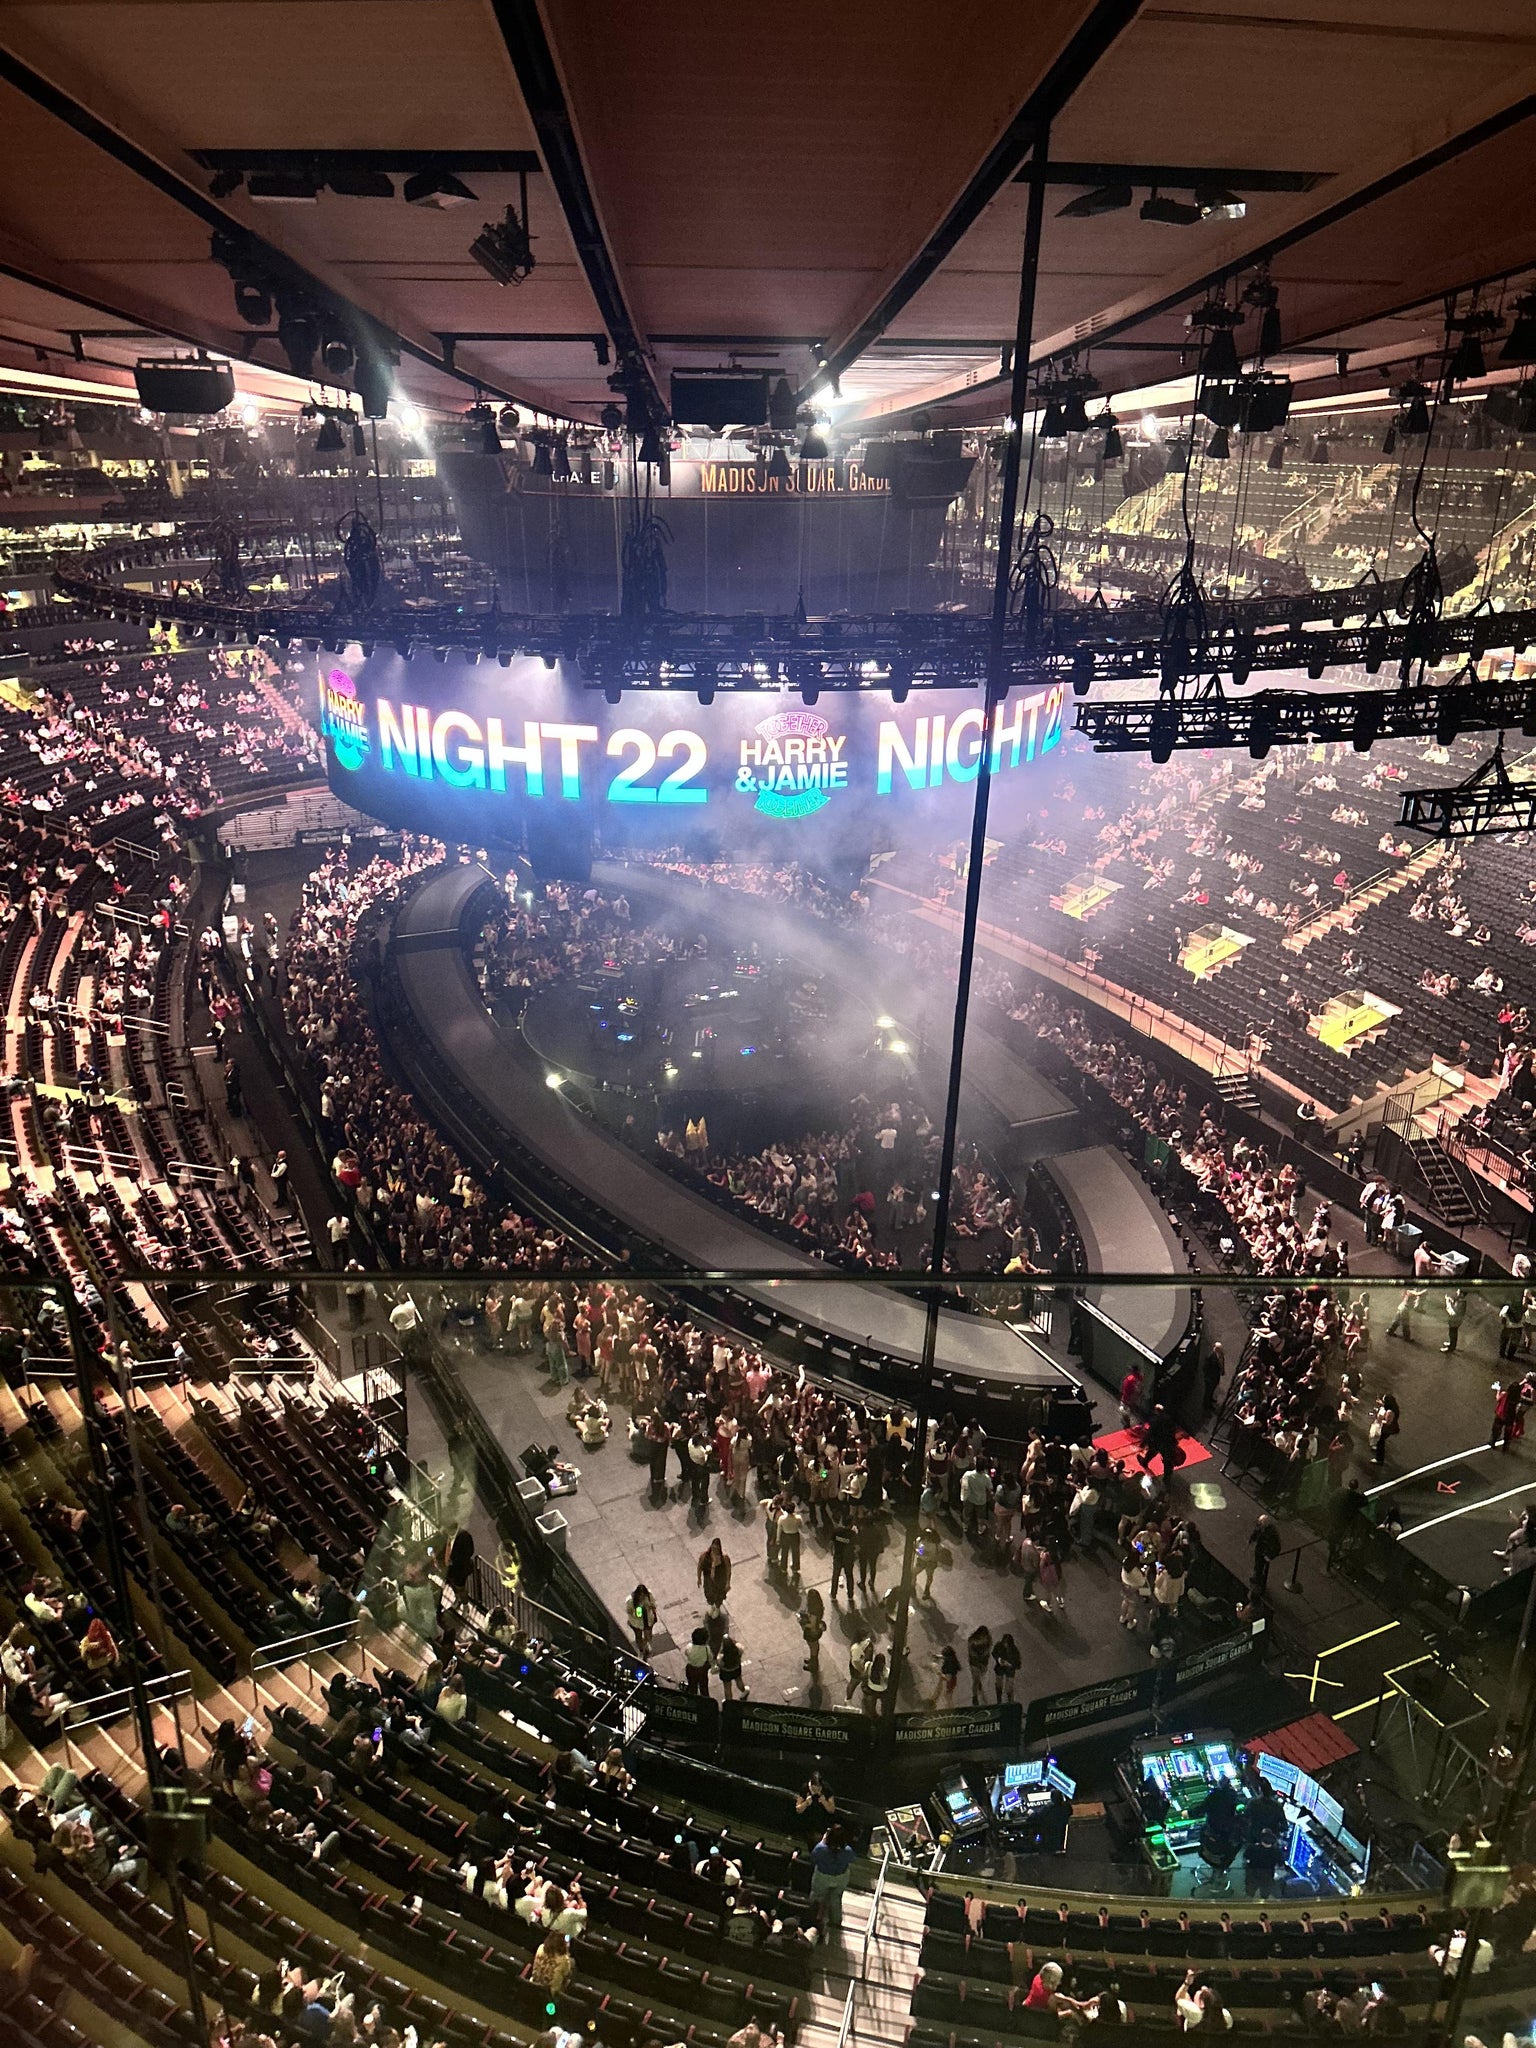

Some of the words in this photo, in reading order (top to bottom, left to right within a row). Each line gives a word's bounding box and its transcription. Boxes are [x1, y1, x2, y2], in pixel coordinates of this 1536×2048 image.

[327, 688, 365, 725] HARRY
[377, 697, 599, 800] NIGHT
[606, 727, 709, 803] 22
[740, 736, 848, 766] HARRY
[877, 690, 1046, 794] NIGHT
[666, 1705, 698, 1722] GARDEN
[1045, 1706, 1079, 1723] MADISON
[1109, 1688, 1138, 1705] GARDEN
[742, 1718, 780, 1734] MADISON
[781, 1723, 813, 1738] SQUARE
[815, 1726, 849, 1741] GARDEN
[896, 1729, 934, 1741] MADISON
[935, 1725, 967, 1738] SQUARE
[969, 1720, 1001, 1734] GARDEN
